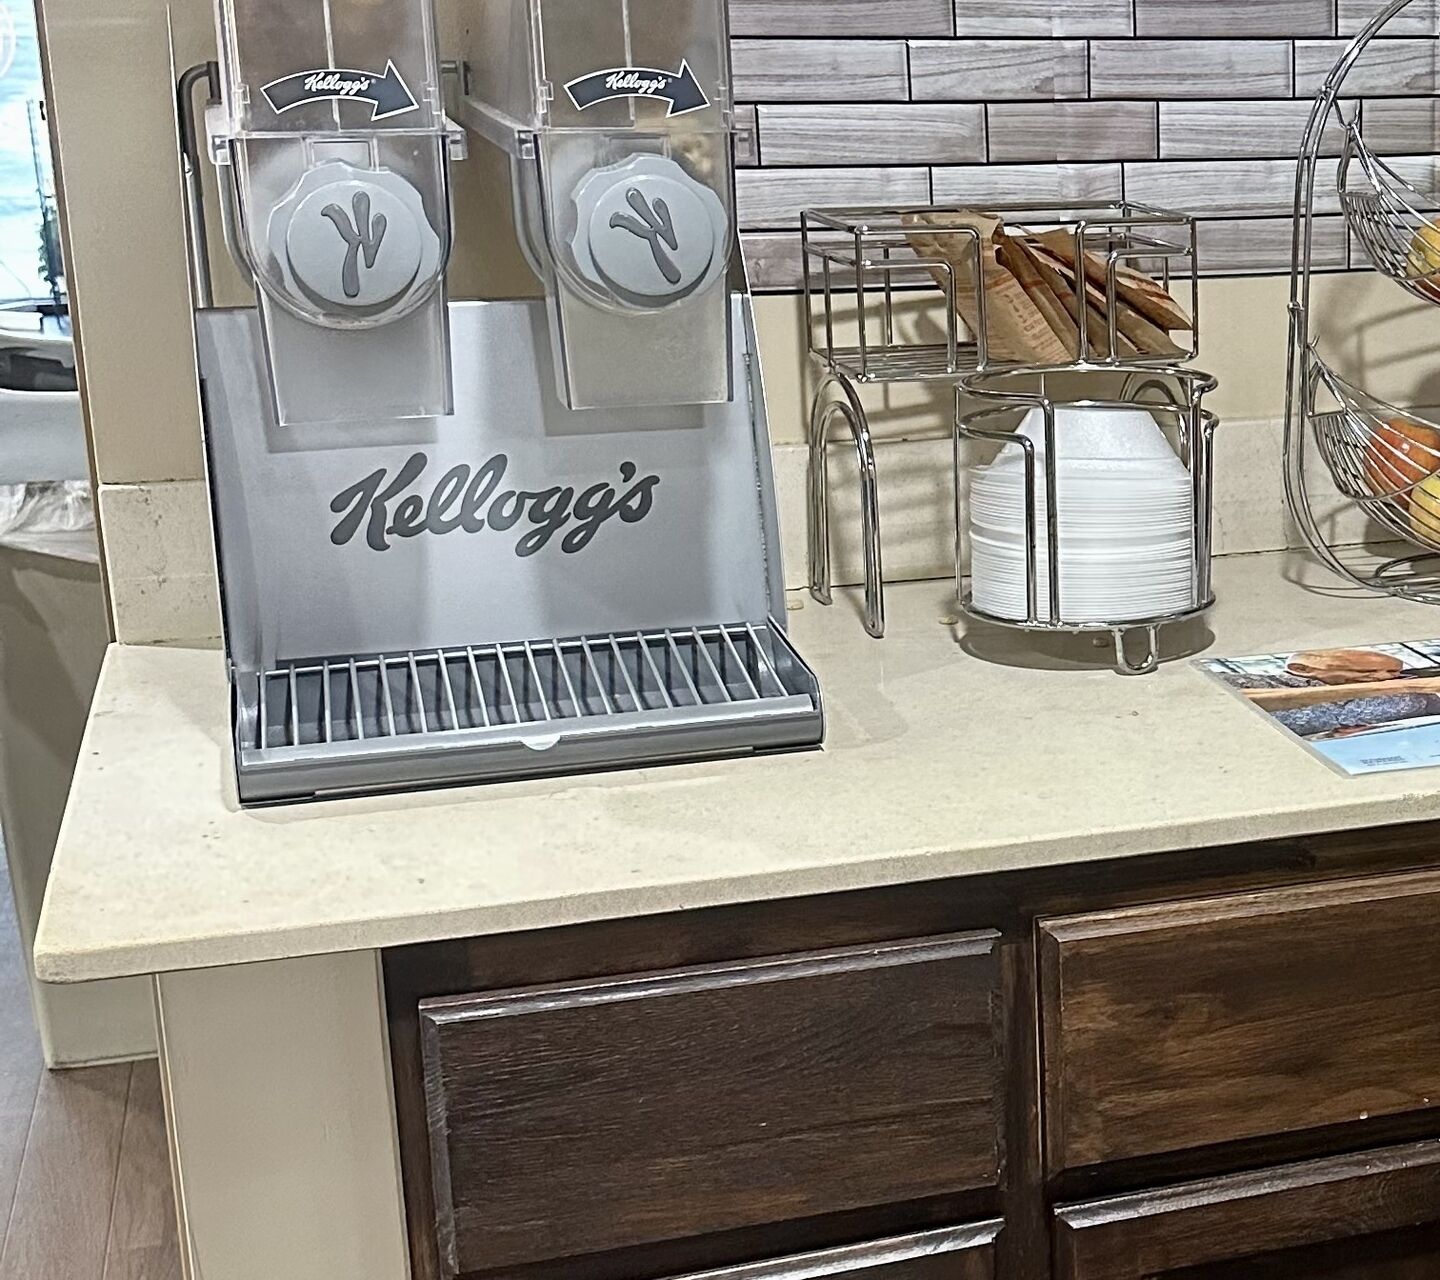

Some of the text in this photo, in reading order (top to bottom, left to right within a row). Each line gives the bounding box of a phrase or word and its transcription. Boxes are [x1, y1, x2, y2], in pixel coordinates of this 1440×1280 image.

[304, 71, 370, 96] Kellogg's
[605, 70, 667, 94] Kellogg's
[329, 452, 661, 558] Kellogg's
